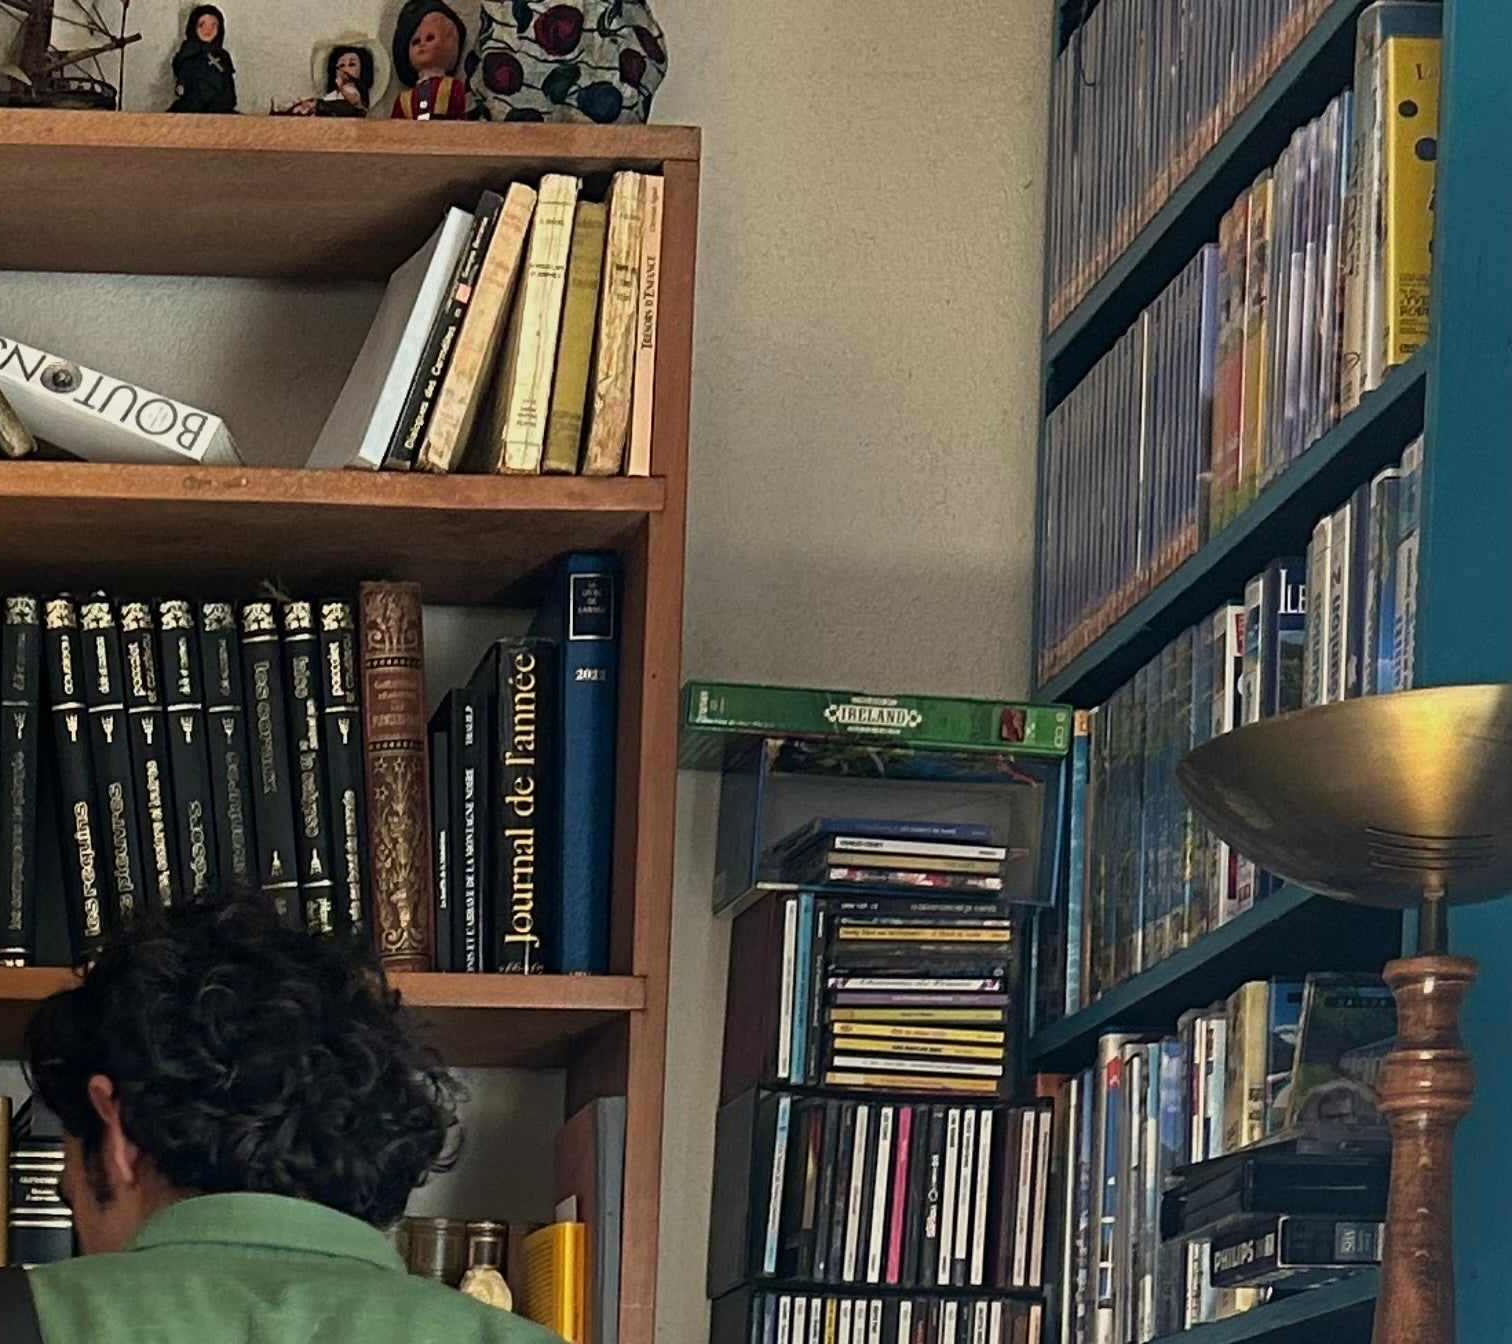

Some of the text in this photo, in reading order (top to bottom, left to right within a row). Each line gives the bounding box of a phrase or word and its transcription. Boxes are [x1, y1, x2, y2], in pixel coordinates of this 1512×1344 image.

[403, 400, 431, 451] Dialogues
[423, 379, 438, 399] des
[840, 707, 906, 724] IRELAND
[504, 650, 541, 947] Journal de l'année
[73, 802, 102, 935] les requins
[1213, 1239, 1255, 1273] PHILIPS
